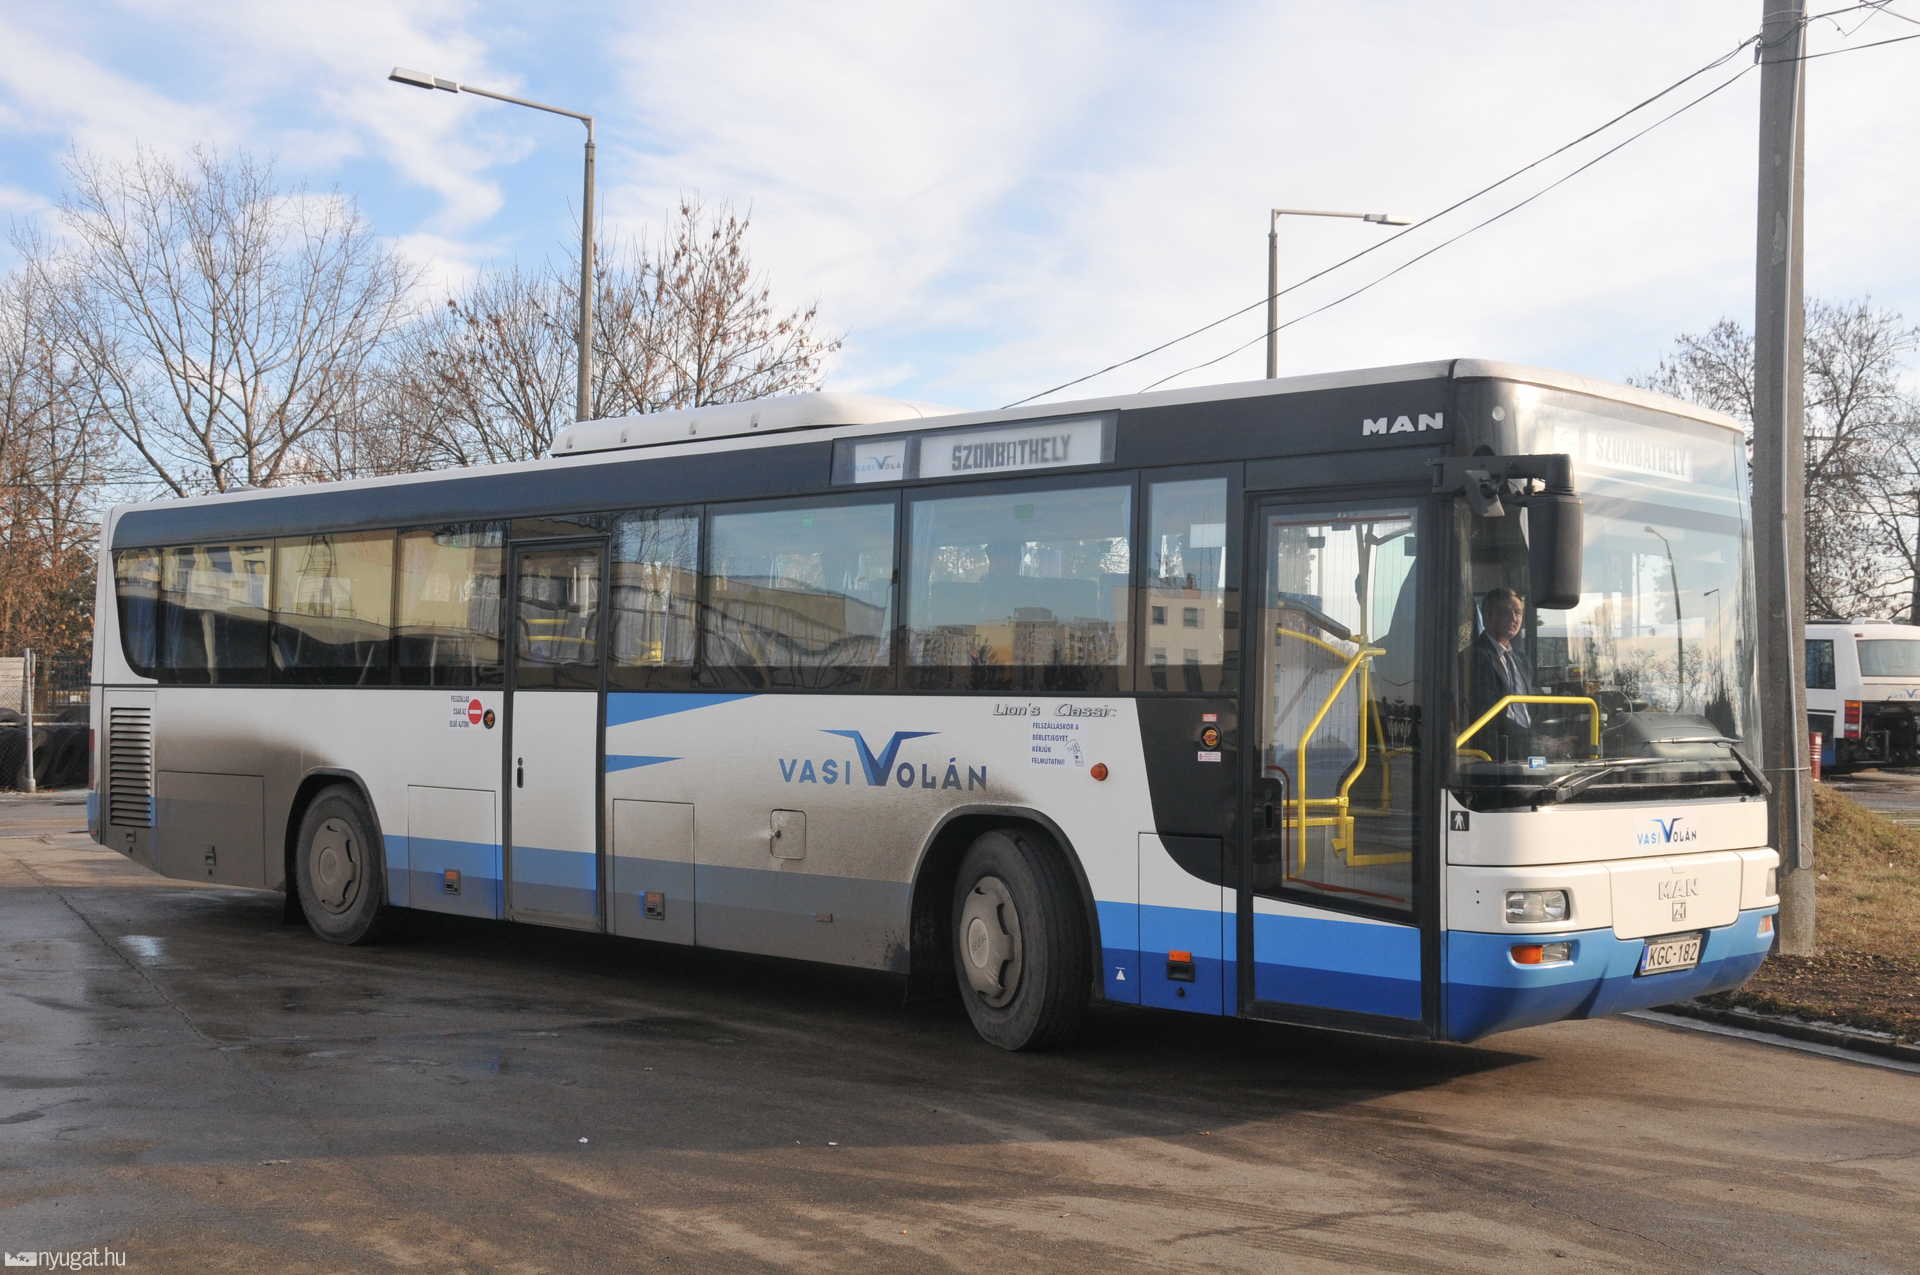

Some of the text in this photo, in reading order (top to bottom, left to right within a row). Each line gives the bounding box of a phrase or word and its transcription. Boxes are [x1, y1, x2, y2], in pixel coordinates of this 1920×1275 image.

[1362, 412, 1443, 436] MAN
[992, 703, 1118, 718] Lion's Classic
[779, 729, 987, 791] VASI VOLÁN
[1637, 817, 1697, 845] VASI VOLÁN
[1657, 878, 1699, 901] MAN
[1648, 942, 1698, 967] KGC-182
